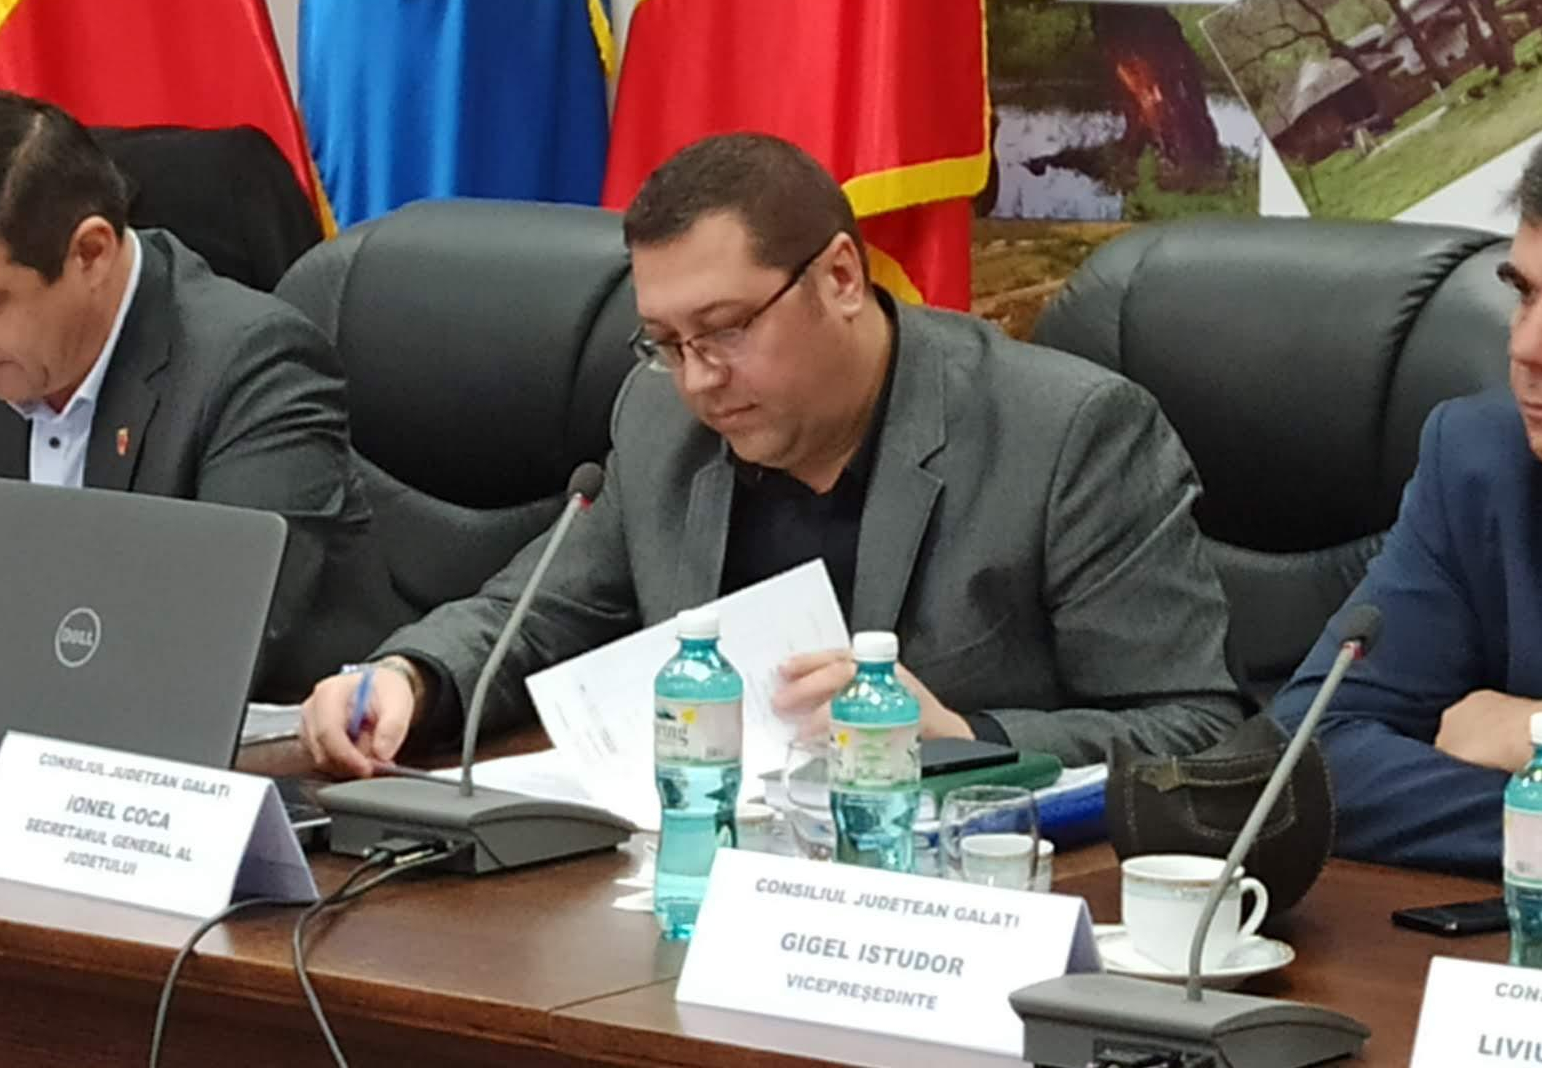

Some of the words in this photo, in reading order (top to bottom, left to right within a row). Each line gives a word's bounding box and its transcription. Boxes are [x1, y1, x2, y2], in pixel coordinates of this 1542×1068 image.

[60, 626, 94, 646] DELL
[38, 752, 105, 776] CONSILIUL
[65, 794, 117, 820] IONEL
[122, 805, 171, 830] COCA
[25, 816, 108, 846] SECRETARUL
[111, 834, 172, 859] GENERAL
[175, 847, 193, 862] AL
[755, 877, 848, 905] CONSILIUL
[780, 932, 850, 960] GIGEL
[858, 943, 965, 977] ISTUDOR
